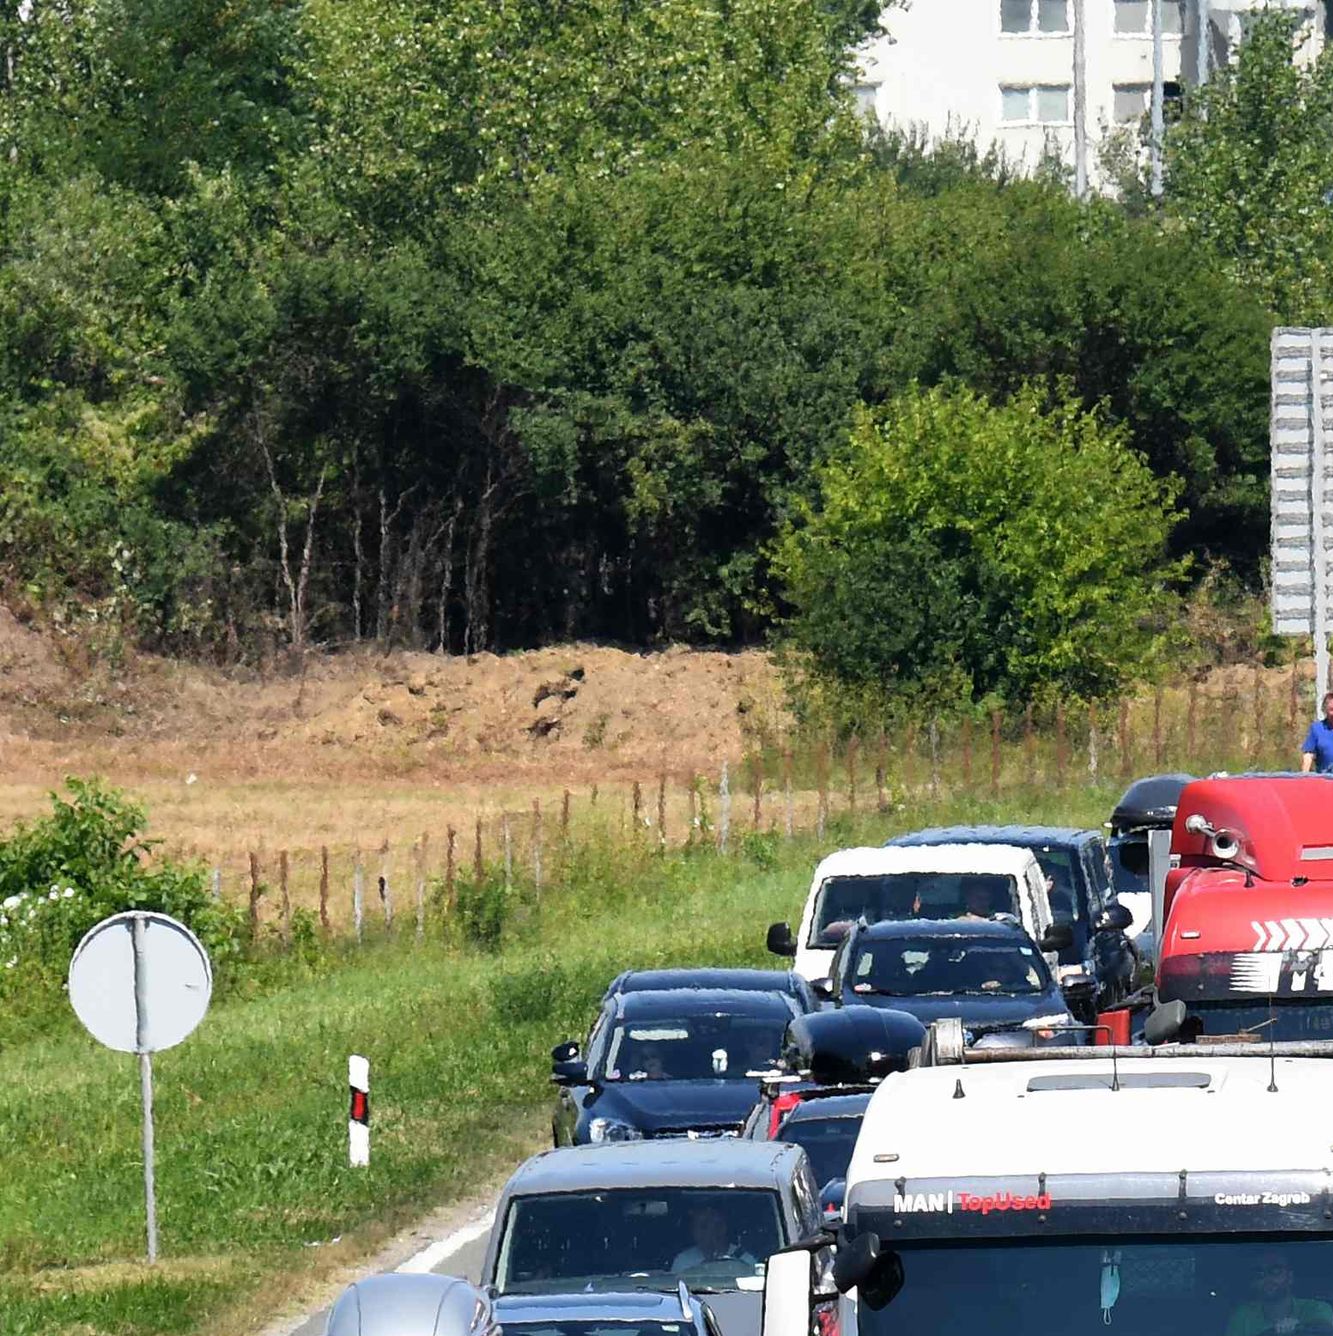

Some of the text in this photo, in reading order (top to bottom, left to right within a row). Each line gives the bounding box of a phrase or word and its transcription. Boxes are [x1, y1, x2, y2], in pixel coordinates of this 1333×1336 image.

[894, 1190, 1051, 1215] MAN TopUsed
[1214, 1191, 1311, 1207] Centar Zagreb
